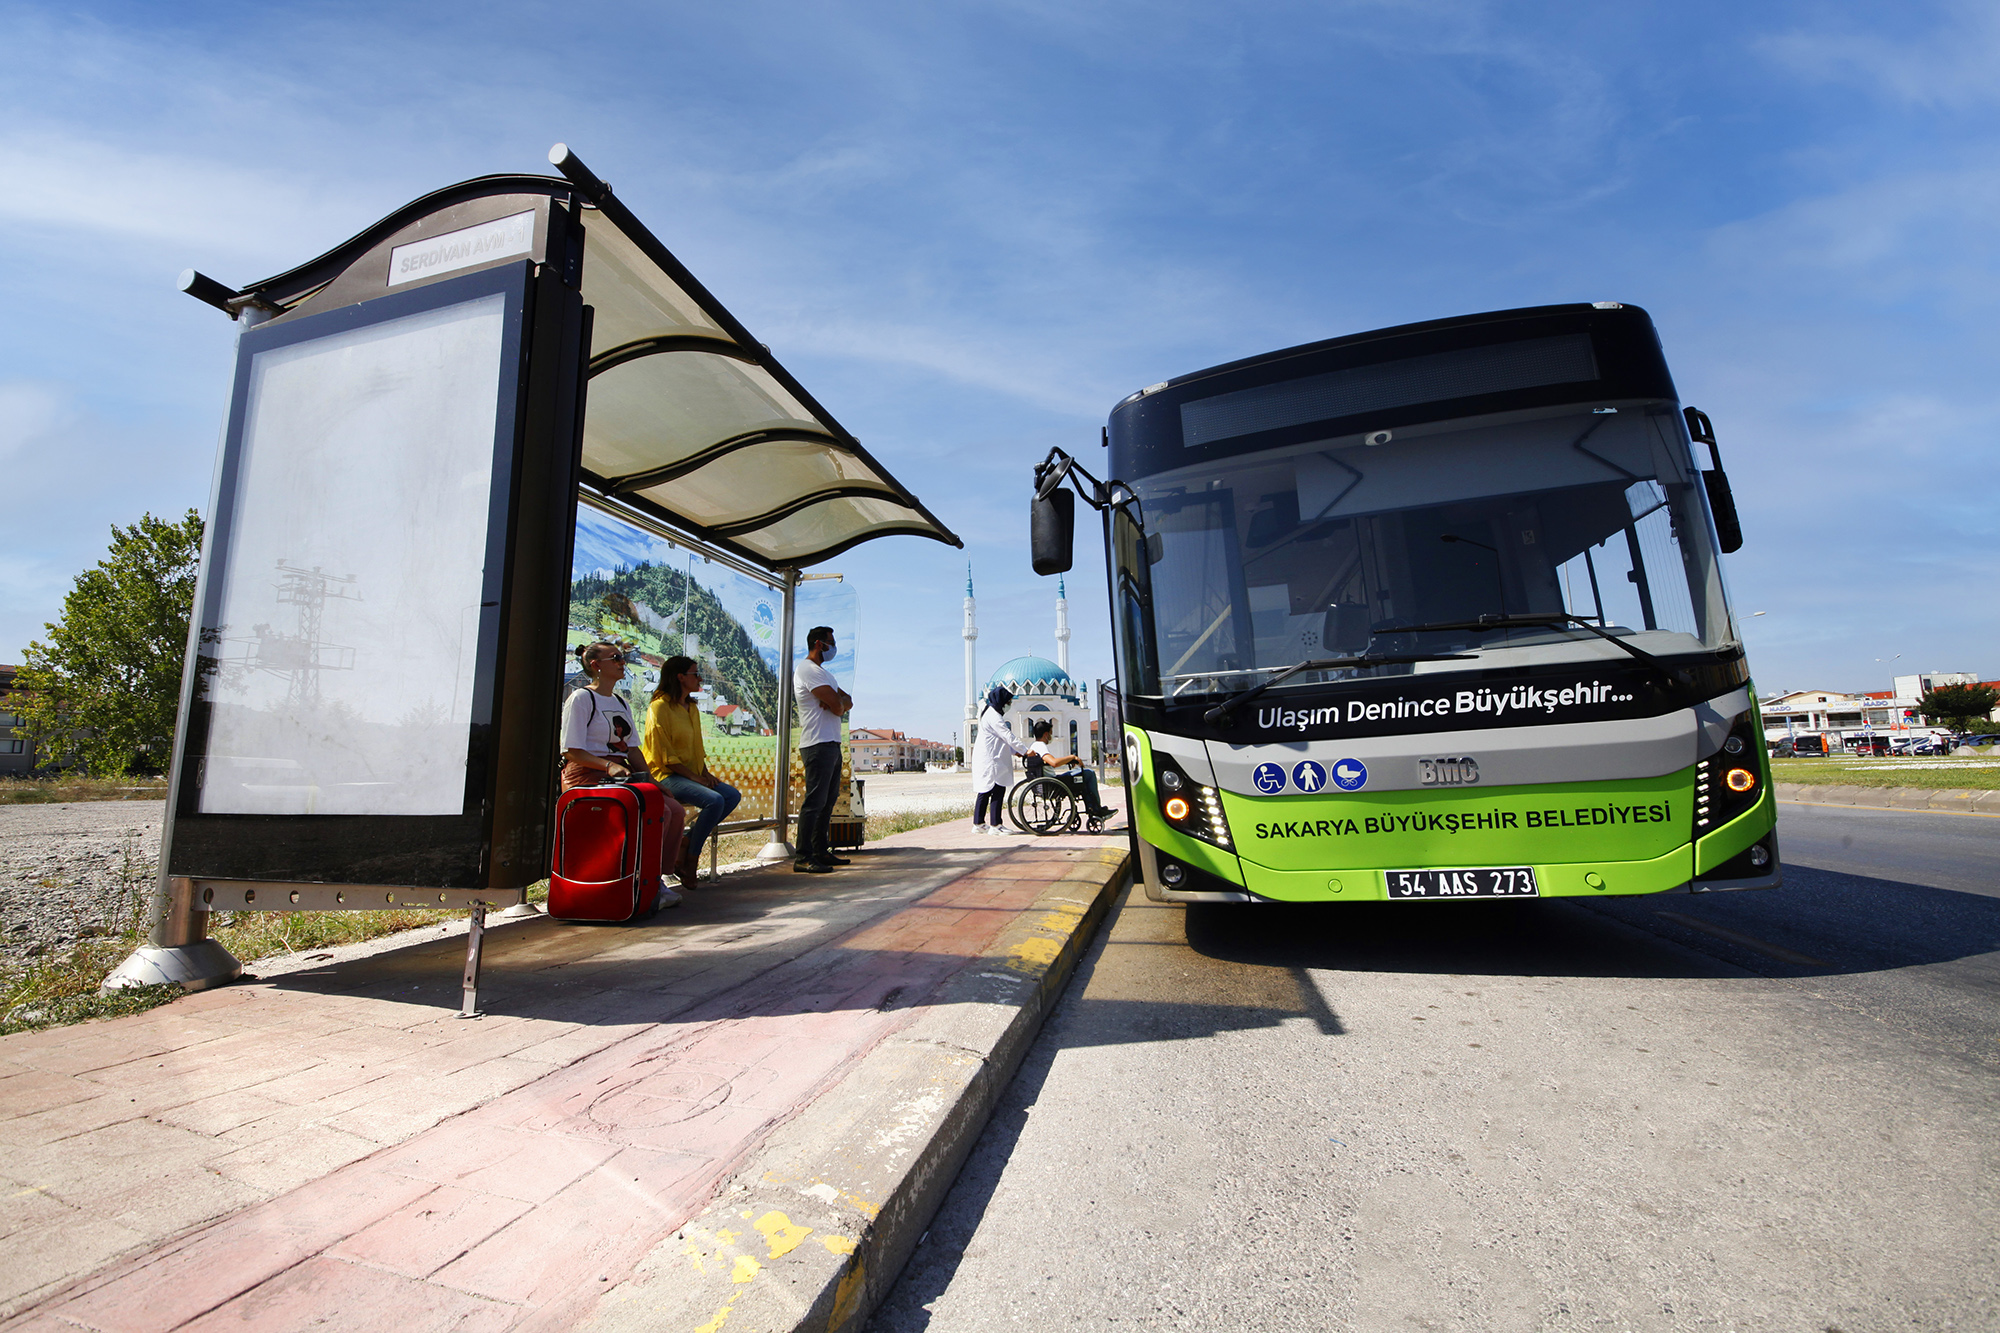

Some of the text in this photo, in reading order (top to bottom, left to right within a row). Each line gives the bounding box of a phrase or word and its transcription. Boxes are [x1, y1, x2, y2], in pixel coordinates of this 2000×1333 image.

[400, 241, 471, 273] SERDİVAN
[473, 232, 505, 255] AVM
[518, 227, 525, 243] 1
[1258, 680, 1633, 732] Ulaşım Denince Büyükşehir...
[1418, 756, 1479, 785] BMC
[1255, 800, 1671, 839] SAKARYA BÜYÜKŞEHİR BELEDİYESİ
[1399, 871, 1532, 896] 54 AAS 273
